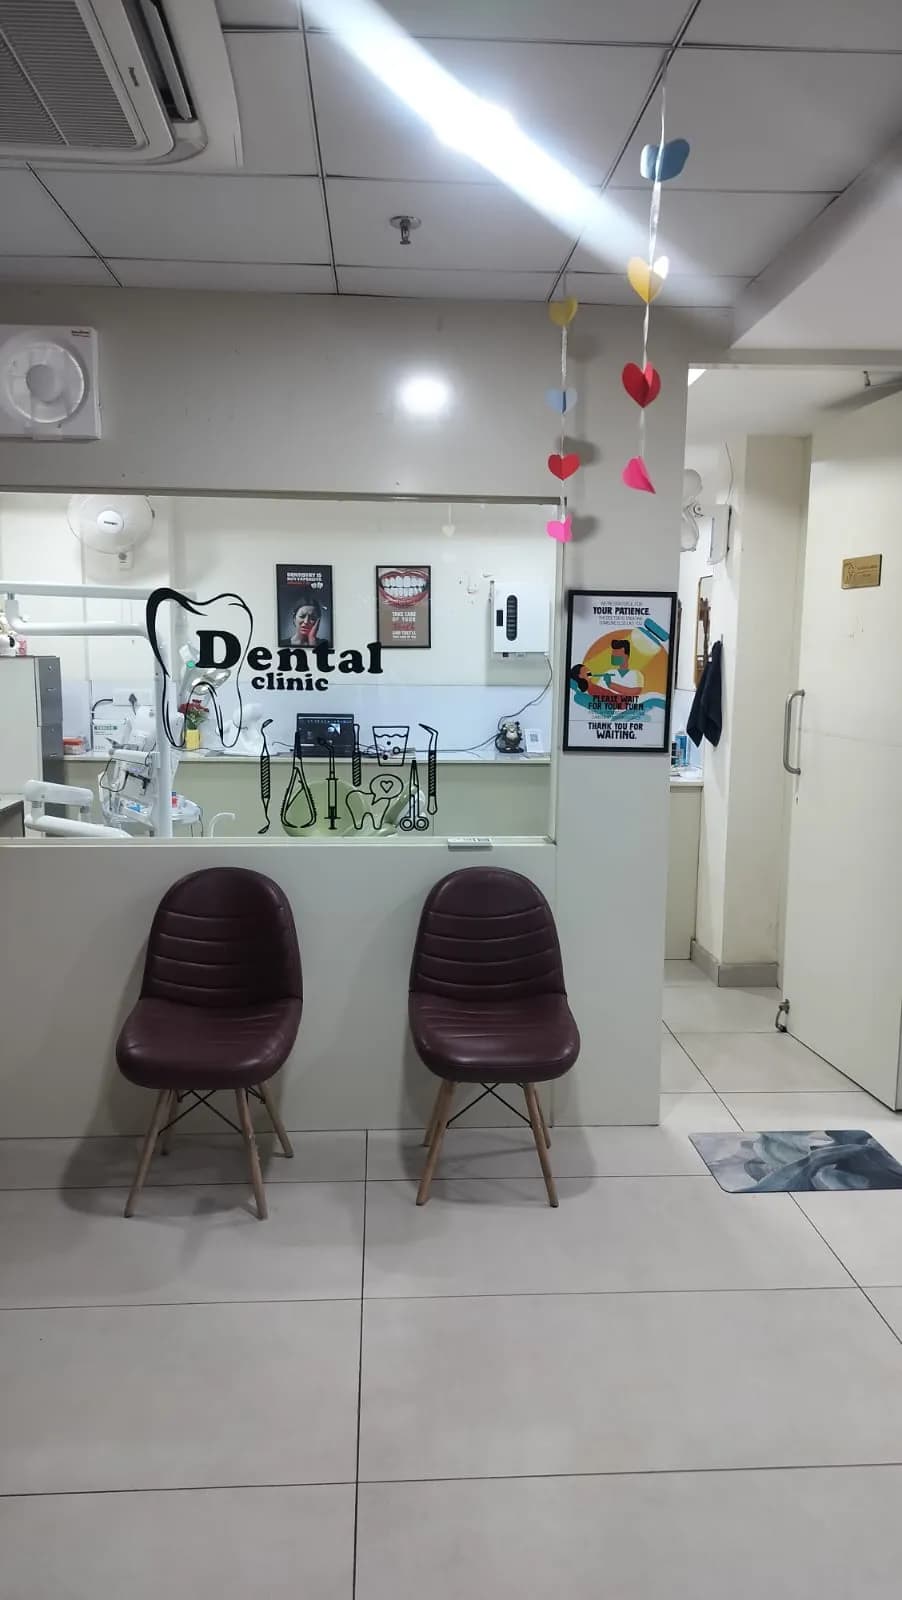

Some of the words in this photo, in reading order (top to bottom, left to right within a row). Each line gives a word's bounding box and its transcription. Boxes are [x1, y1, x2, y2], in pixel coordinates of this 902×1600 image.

[593, 606, 612, 615] YOUR
[195, 630, 384, 674] Dental
[251, 672, 329, 691] clinic
[588, 702, 602, 710] FOR
[626, 703, 644, 711] TURN
[588, 722, 612, 730] THANK
[615, 722, 628, 730] YOU
[629, 723, 644, 731] FOR
